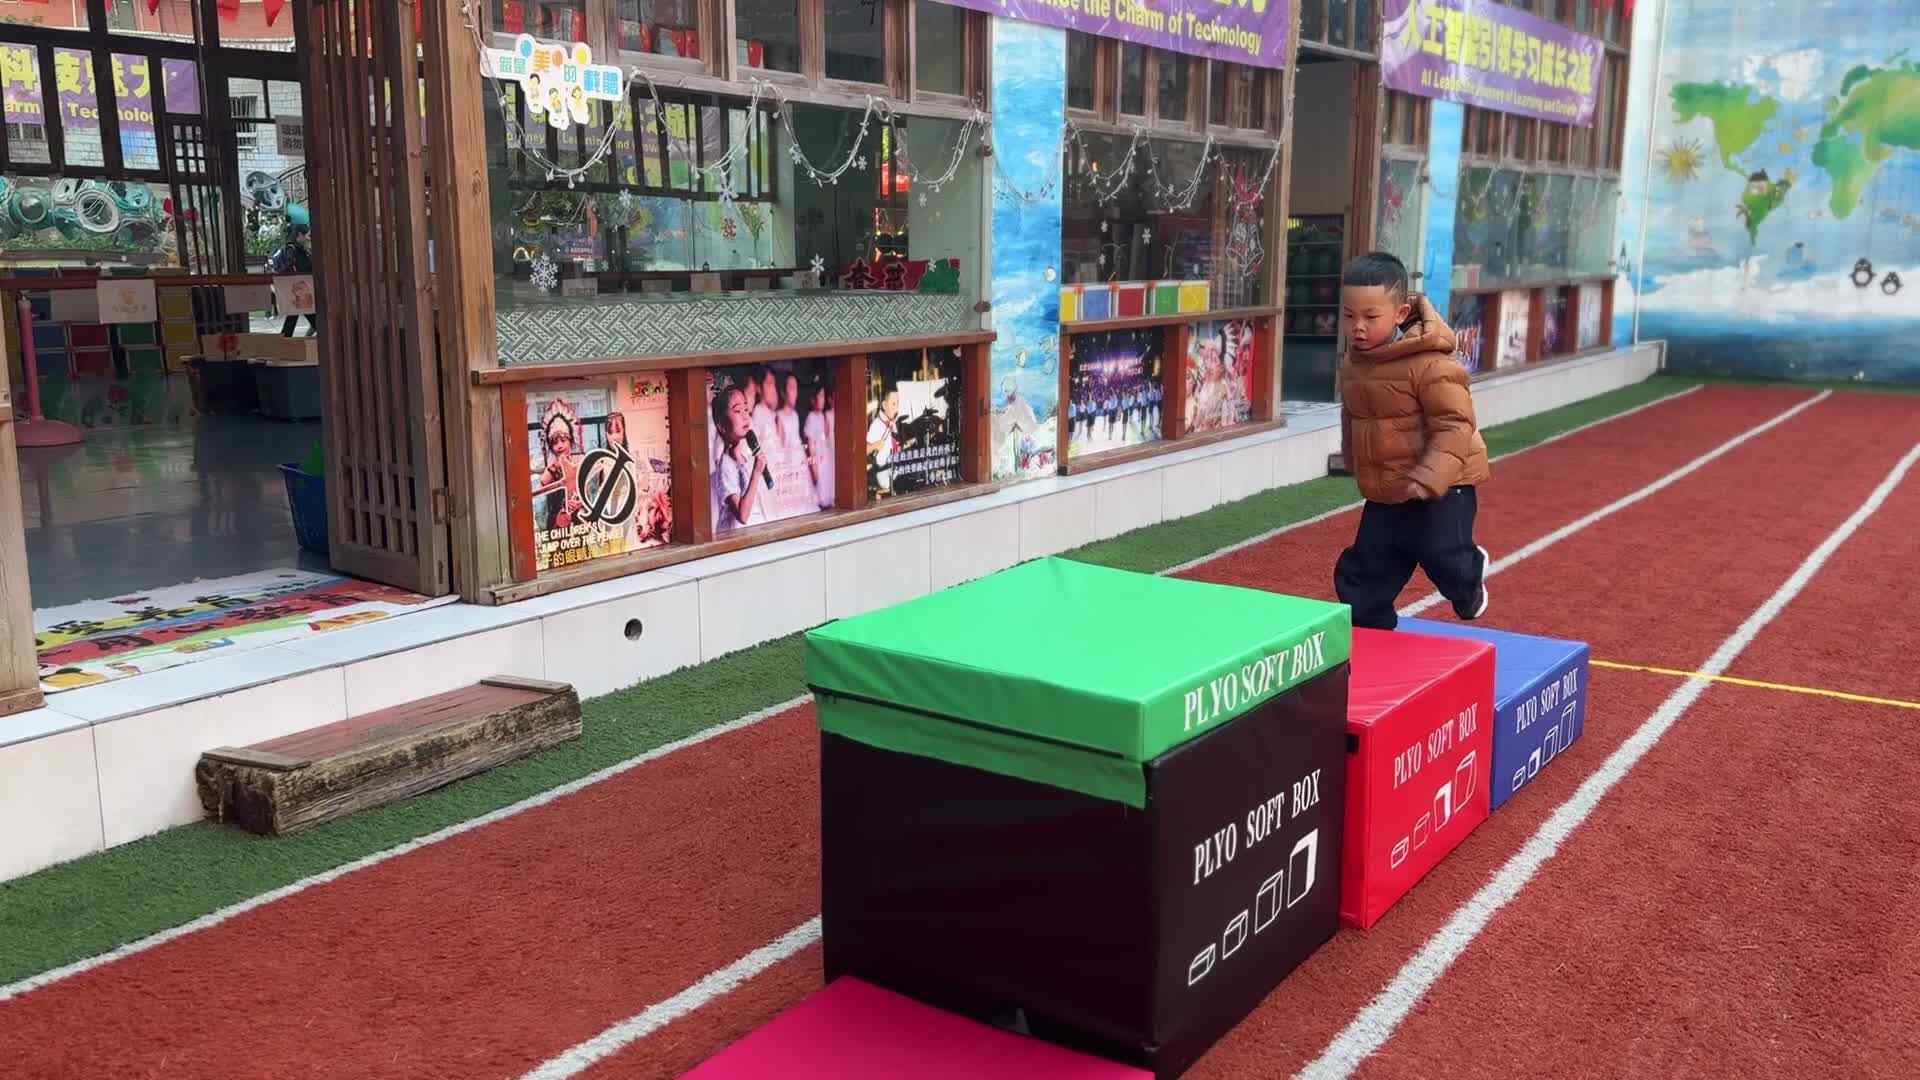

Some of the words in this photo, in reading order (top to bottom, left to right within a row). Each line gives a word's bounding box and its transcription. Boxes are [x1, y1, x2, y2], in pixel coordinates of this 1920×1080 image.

[1115, 0, 1165, 31] Charm
[1168, 9, 1182, 35] of
[1186, 11, 1263, 56] Technology
[1184, 673, 1237, 732] PLYO
[1241, 650, 1289, 704] SOFT
[1290, 631, 1326, 680] BOX
[1516, 695, 1537, 734] PLYO
[1540, 680, 1560, 716] SOFT
[1562, 667, 1579, 700] BOX
[1393, 741, 1422, 790] PLYO
[1427, 719, 1454, 763] SOFT
[1459, 702, 1479, 742] BOX
[1193, 823, 1237, 885] PLYO
[1246, 792, 1285, 849] SOFT
[1291, 768, 1321, 819] BOX
